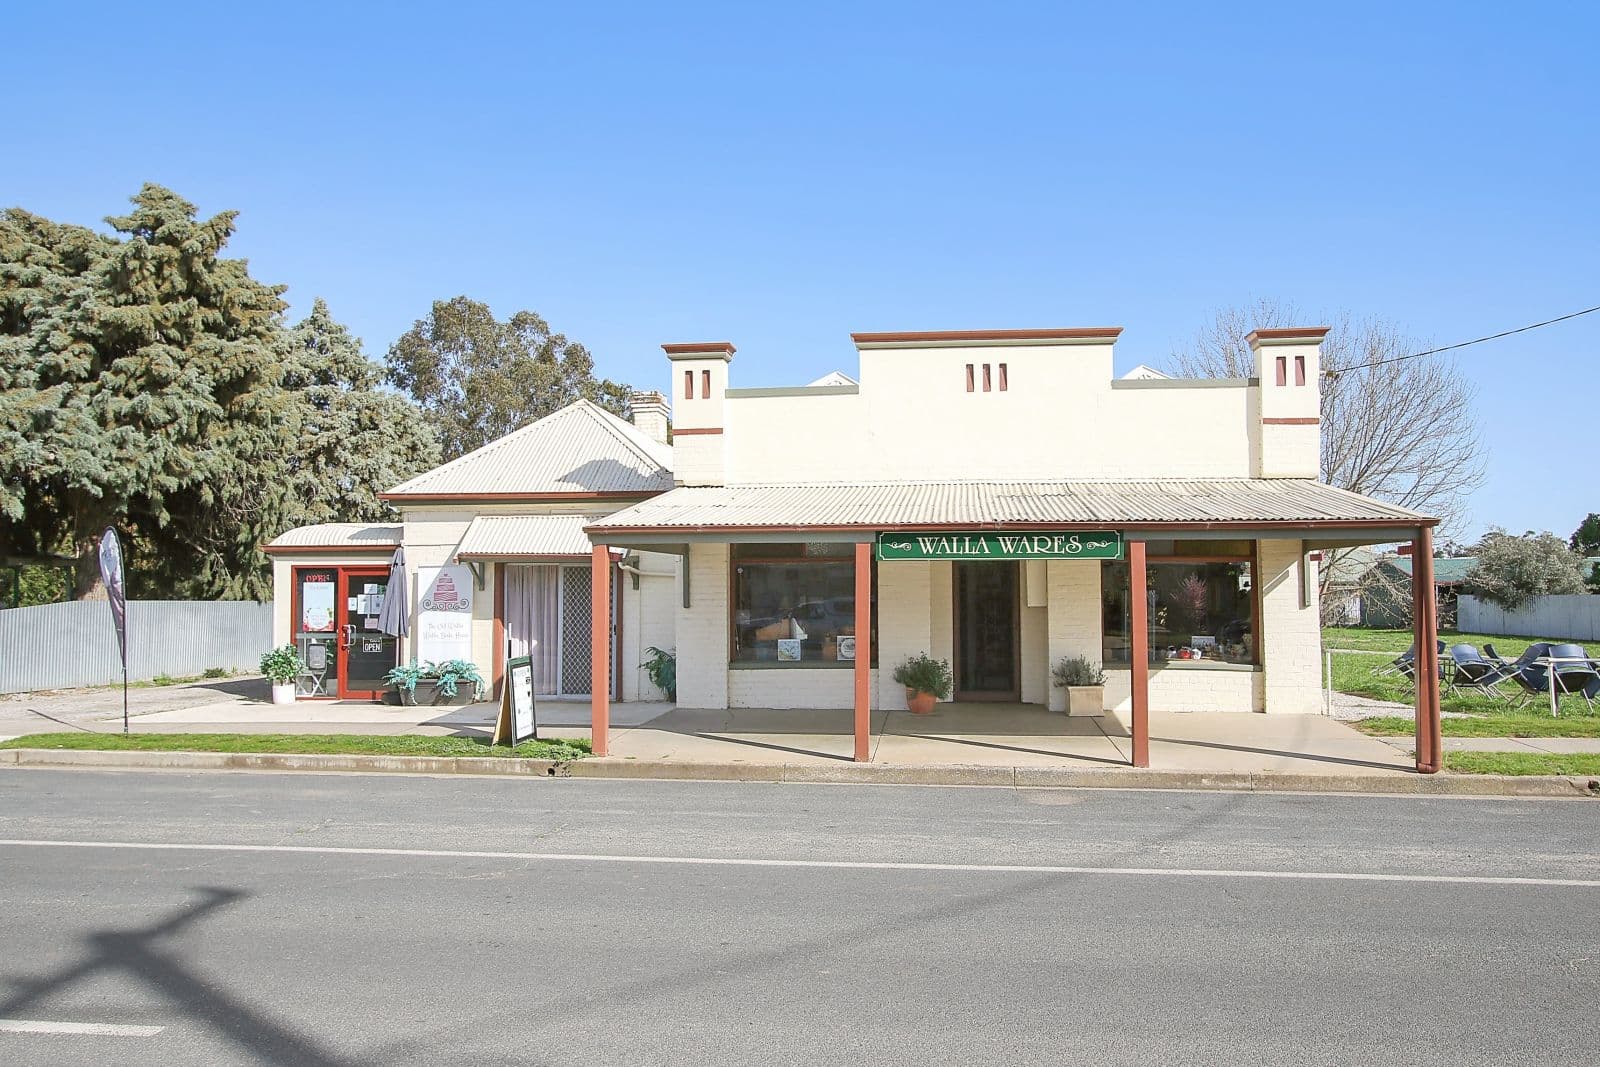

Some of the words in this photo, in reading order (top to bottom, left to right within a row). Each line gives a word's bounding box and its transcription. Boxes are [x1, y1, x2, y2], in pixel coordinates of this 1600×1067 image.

[916, 536, 991, 555] WALLA
[996, 535, 1082, 555] WARES
[364, 643, 380, 651] OPEN
